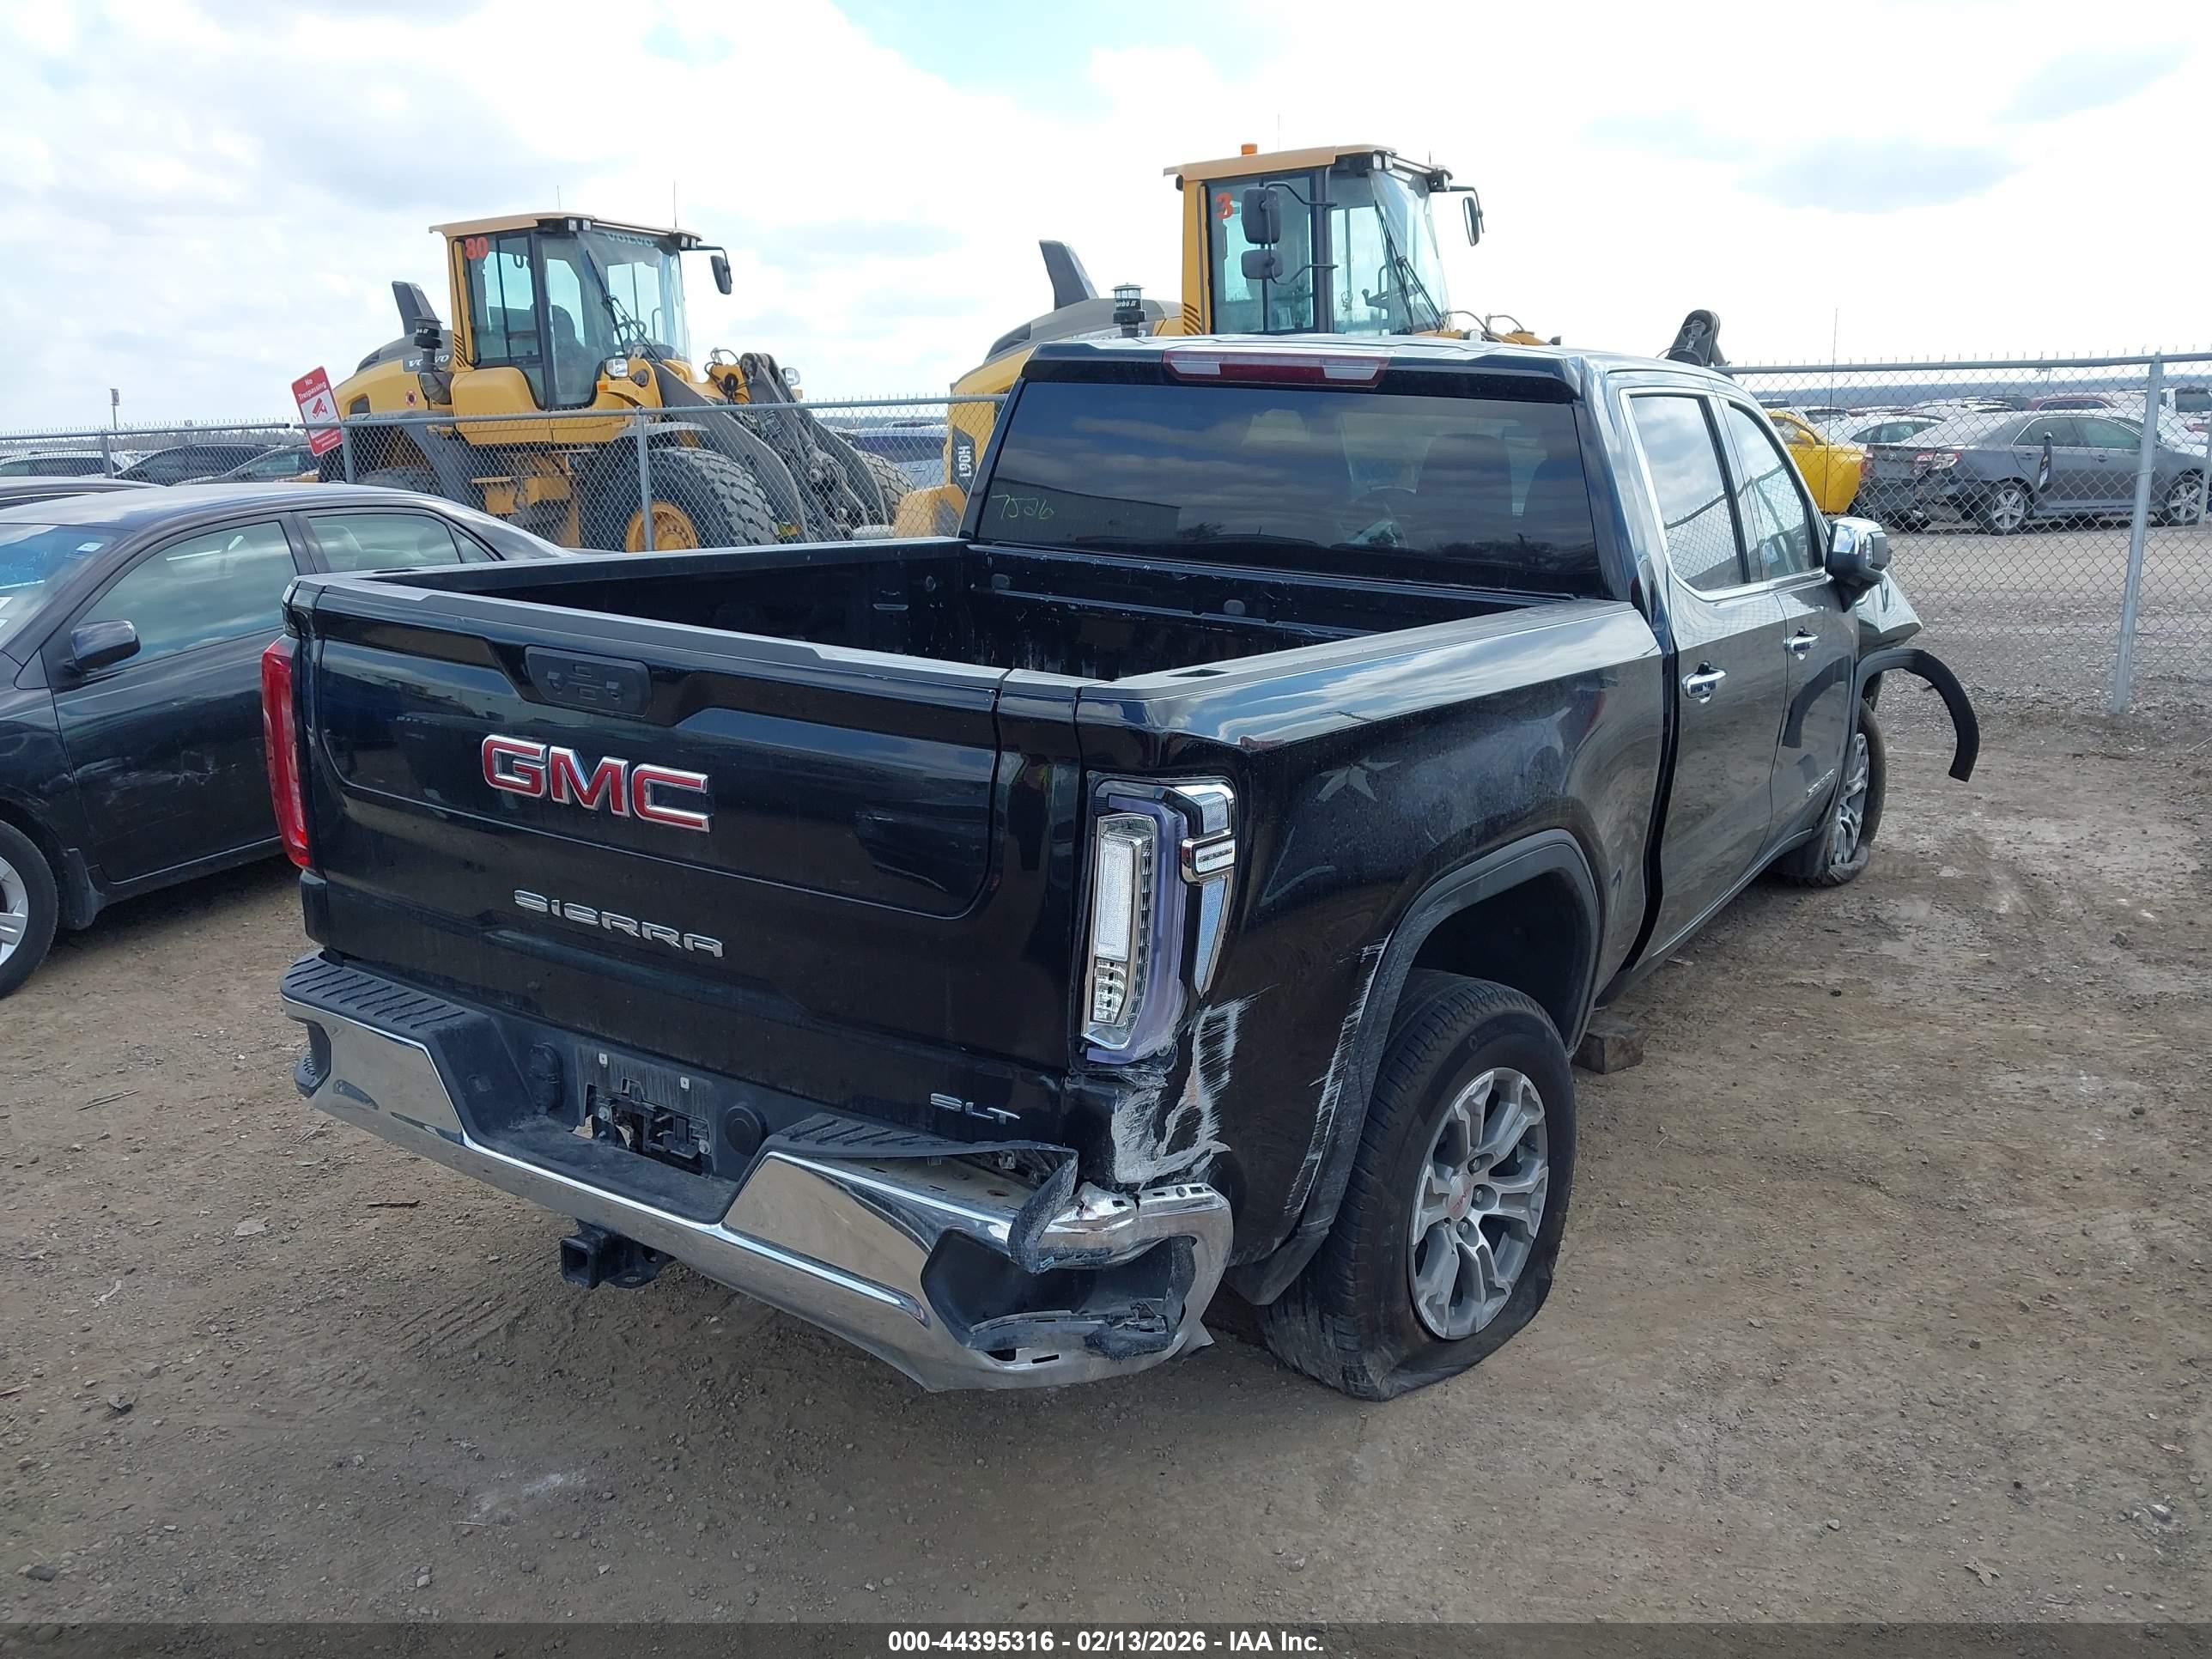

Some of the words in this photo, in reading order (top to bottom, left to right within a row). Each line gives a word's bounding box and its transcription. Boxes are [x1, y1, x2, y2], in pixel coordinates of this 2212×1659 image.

[606, 232, 654, 247] VOLVO
[298, 380, 326, 401] Trespassing
[304, 378, 313, 386] No
[481, 734, 711, 834] GMC
[514, 889, 724, 958] SIERRA
[930, 1092, 1020, 1125] SLT
